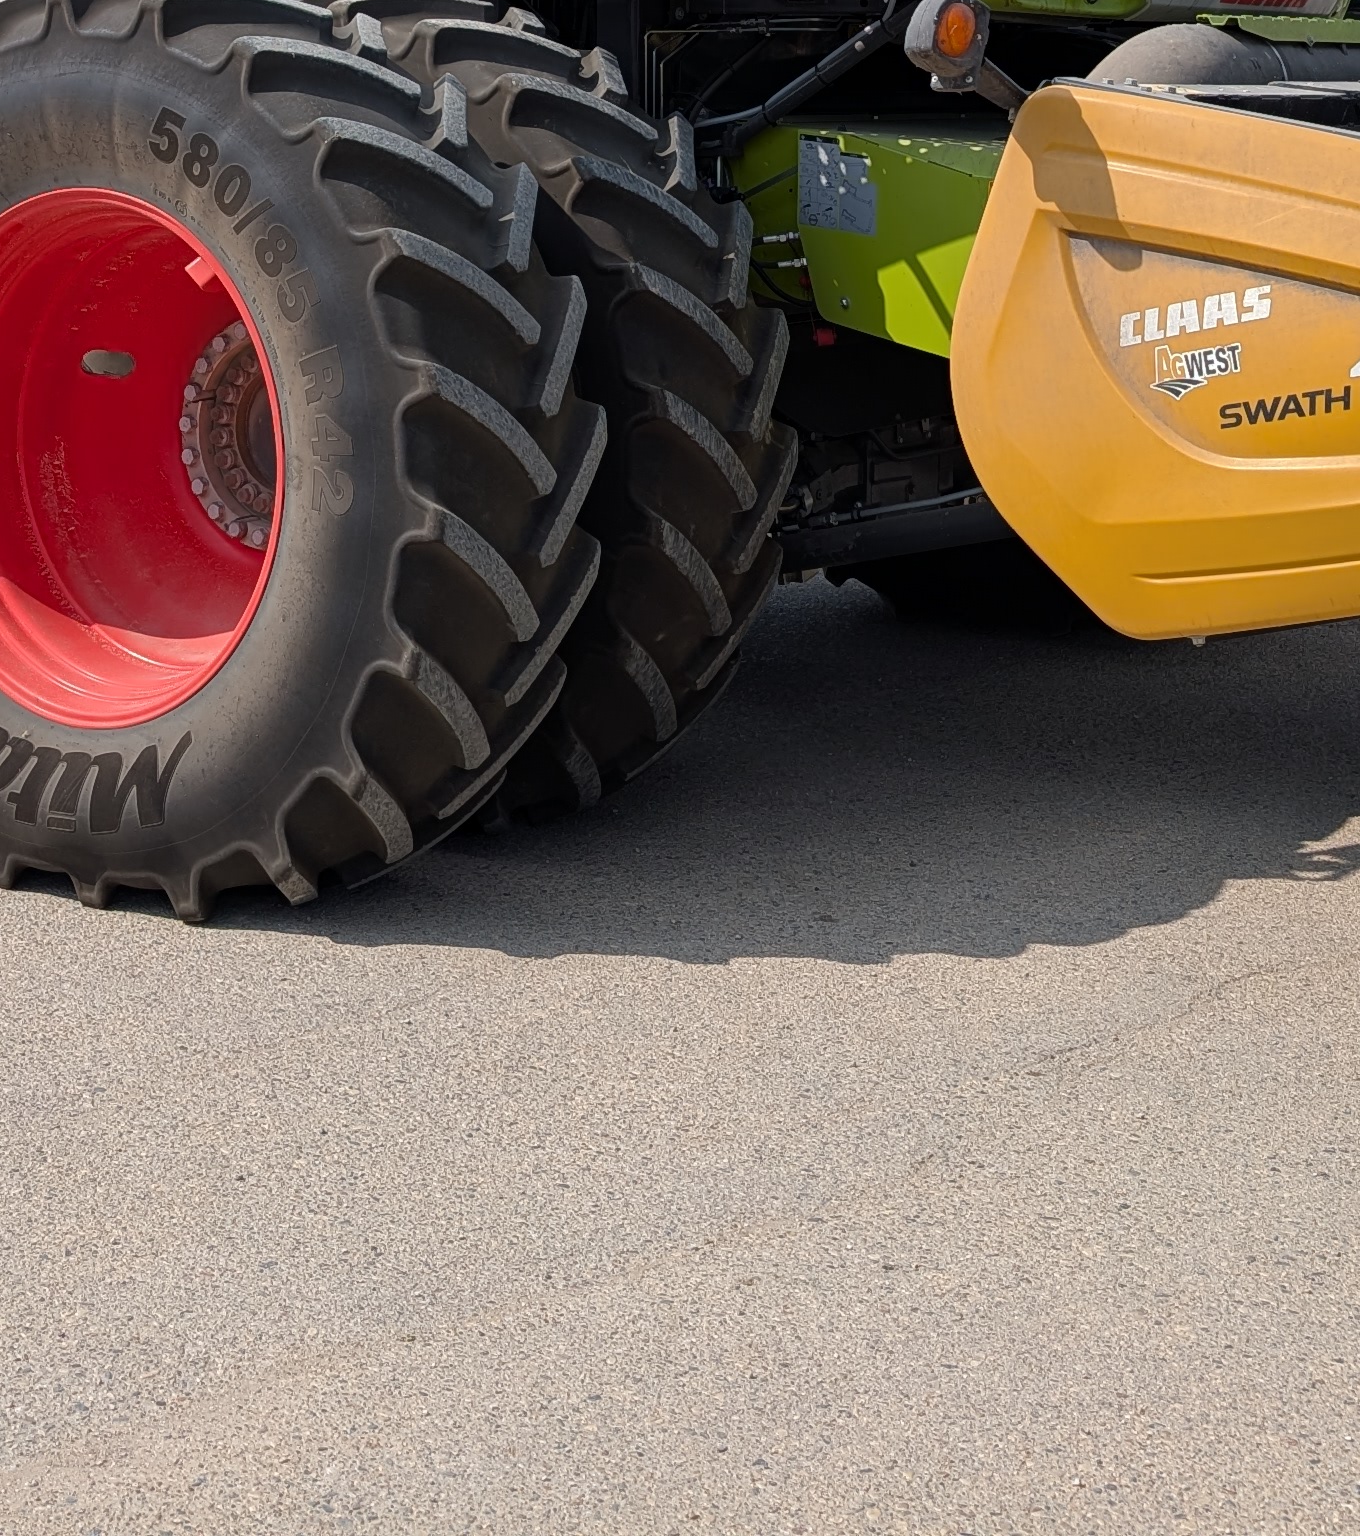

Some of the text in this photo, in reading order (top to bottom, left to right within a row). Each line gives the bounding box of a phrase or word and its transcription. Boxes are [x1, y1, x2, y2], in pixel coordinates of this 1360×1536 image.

[147, 106, 321, 324] 580/85
[1119, 284, 1272, 348] CLAAS
[1218, 385, 1352, 430] SWATH
